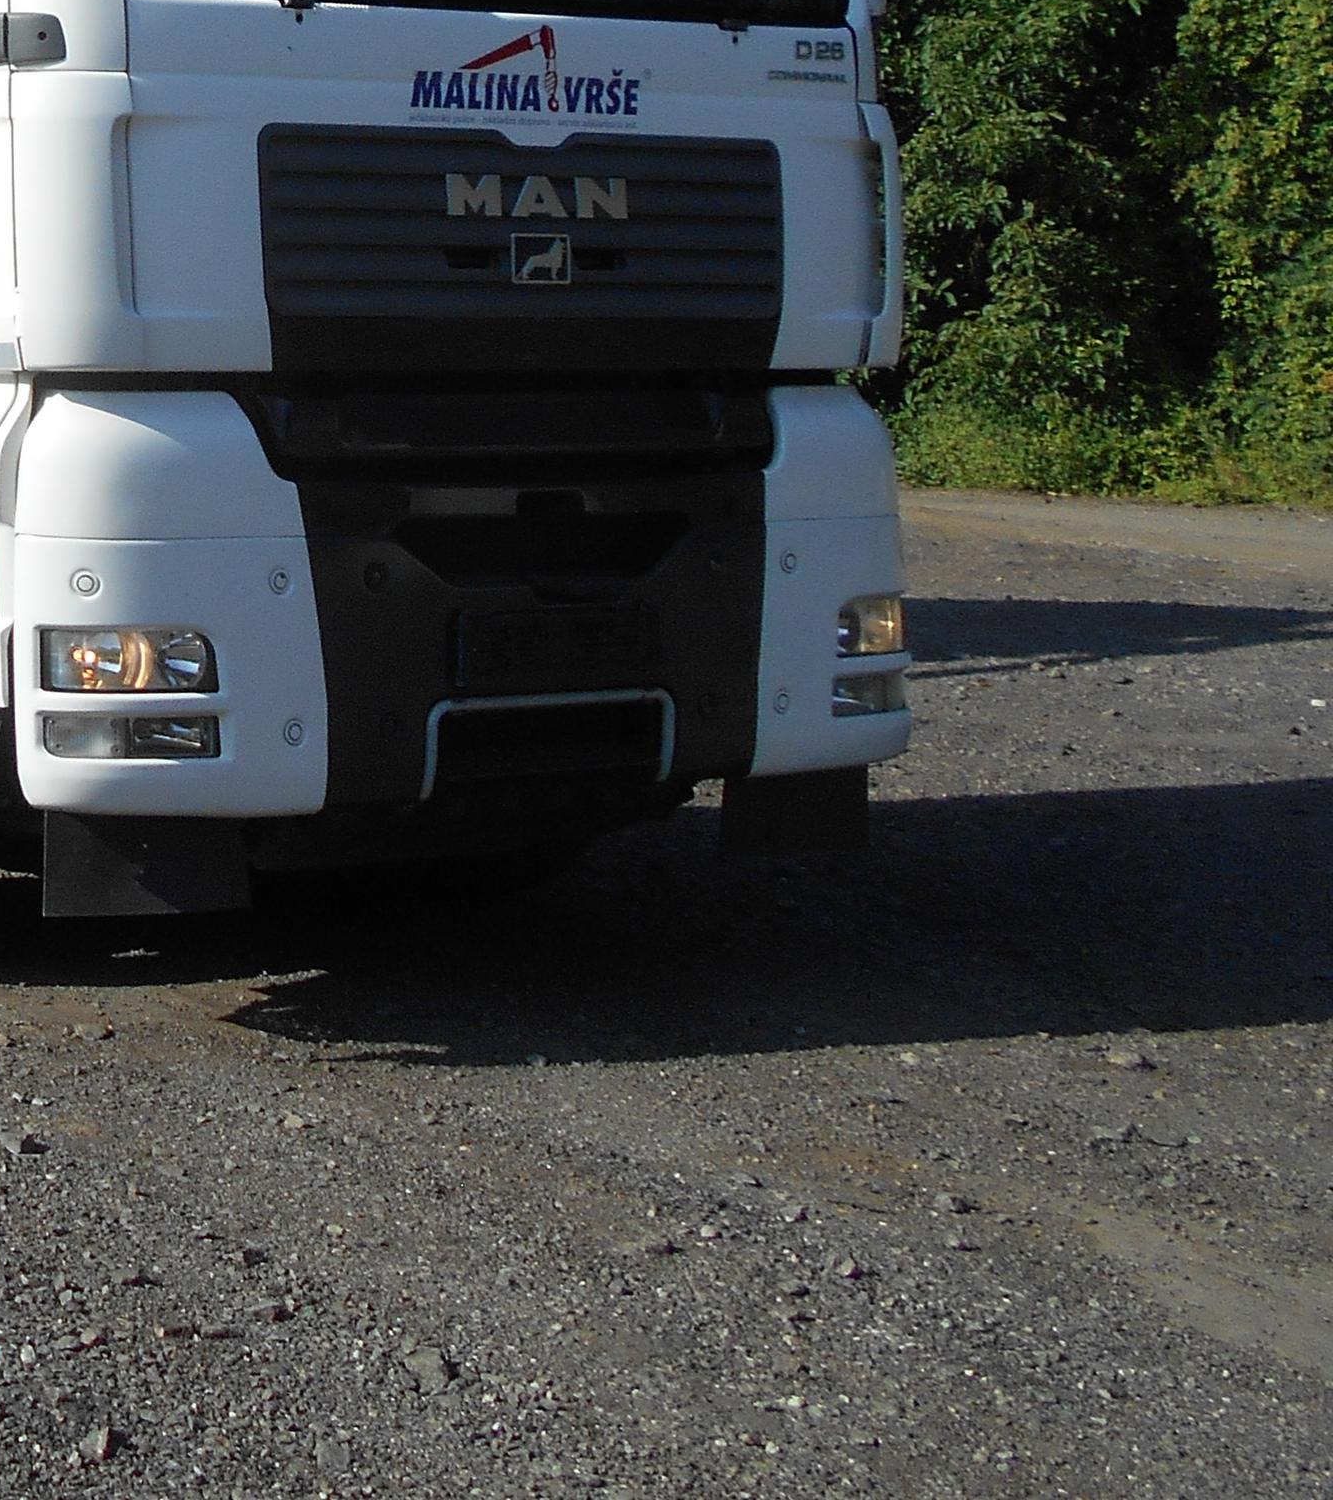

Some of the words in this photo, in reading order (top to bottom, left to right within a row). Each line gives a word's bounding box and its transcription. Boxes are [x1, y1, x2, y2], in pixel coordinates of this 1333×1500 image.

[410, 70, 541, 113] MALINA
[563, 69, 641, 116] VRŠE
[445, 173, 629, 220] MAN
